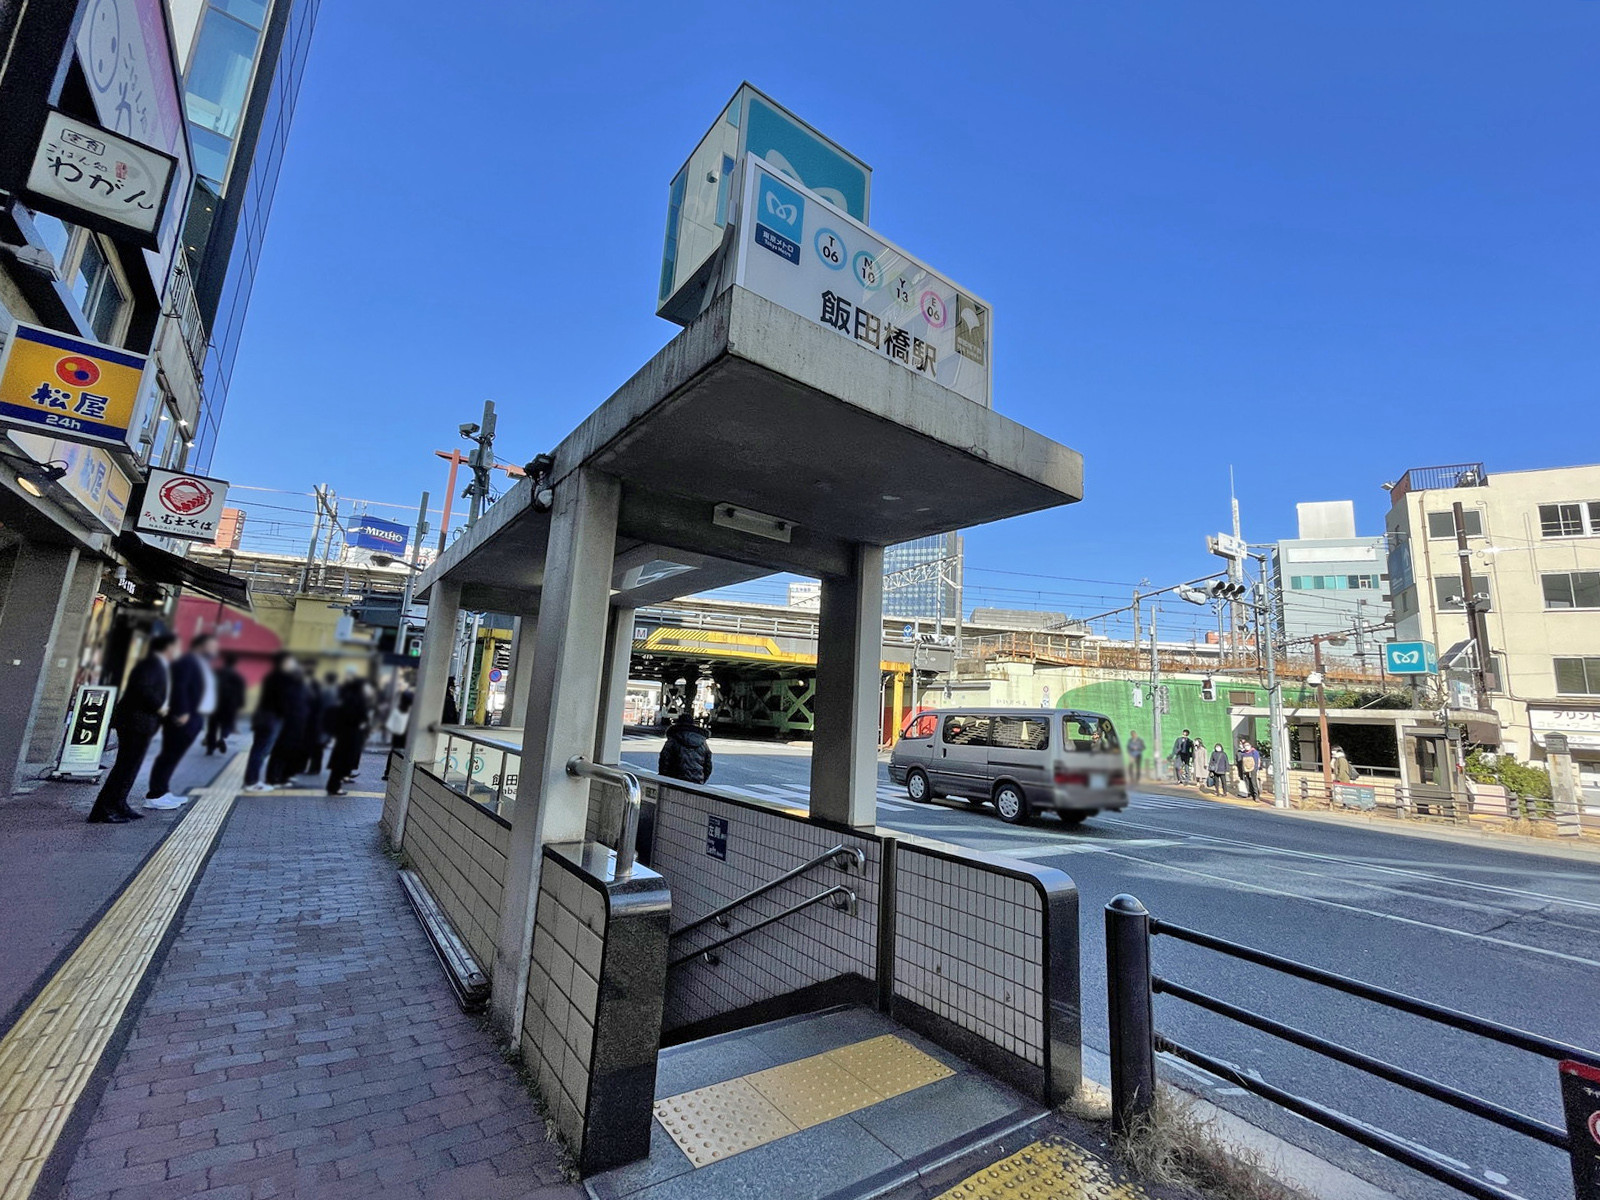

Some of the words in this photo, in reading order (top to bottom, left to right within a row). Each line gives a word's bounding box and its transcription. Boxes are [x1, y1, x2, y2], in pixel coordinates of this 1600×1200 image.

[47, 156, 154, 210] わがん
[762, 230, 794, 254] 東京メトロ
[828, 235, 836, 248] T
[822, 246, 839, 263] 06
[863, 256, 873, 269] N
[861, 269, 876, 284] 10
[899, 278, 906, 289] Y
[896, 287, 909, 304] 13
[930, 296, 937, 307] E
[926, 308, 940, 321] 06
[819, 288, 937, 379] 飯田橋駅
[31, 382, 109, 420] 松屋
[45, 413, 81, 430] 24h
[160, 514, 213, 531] 富士そば
[364, 525, 403, 544] MIZUHO
[80, 690, 105, 745] 肩こり
